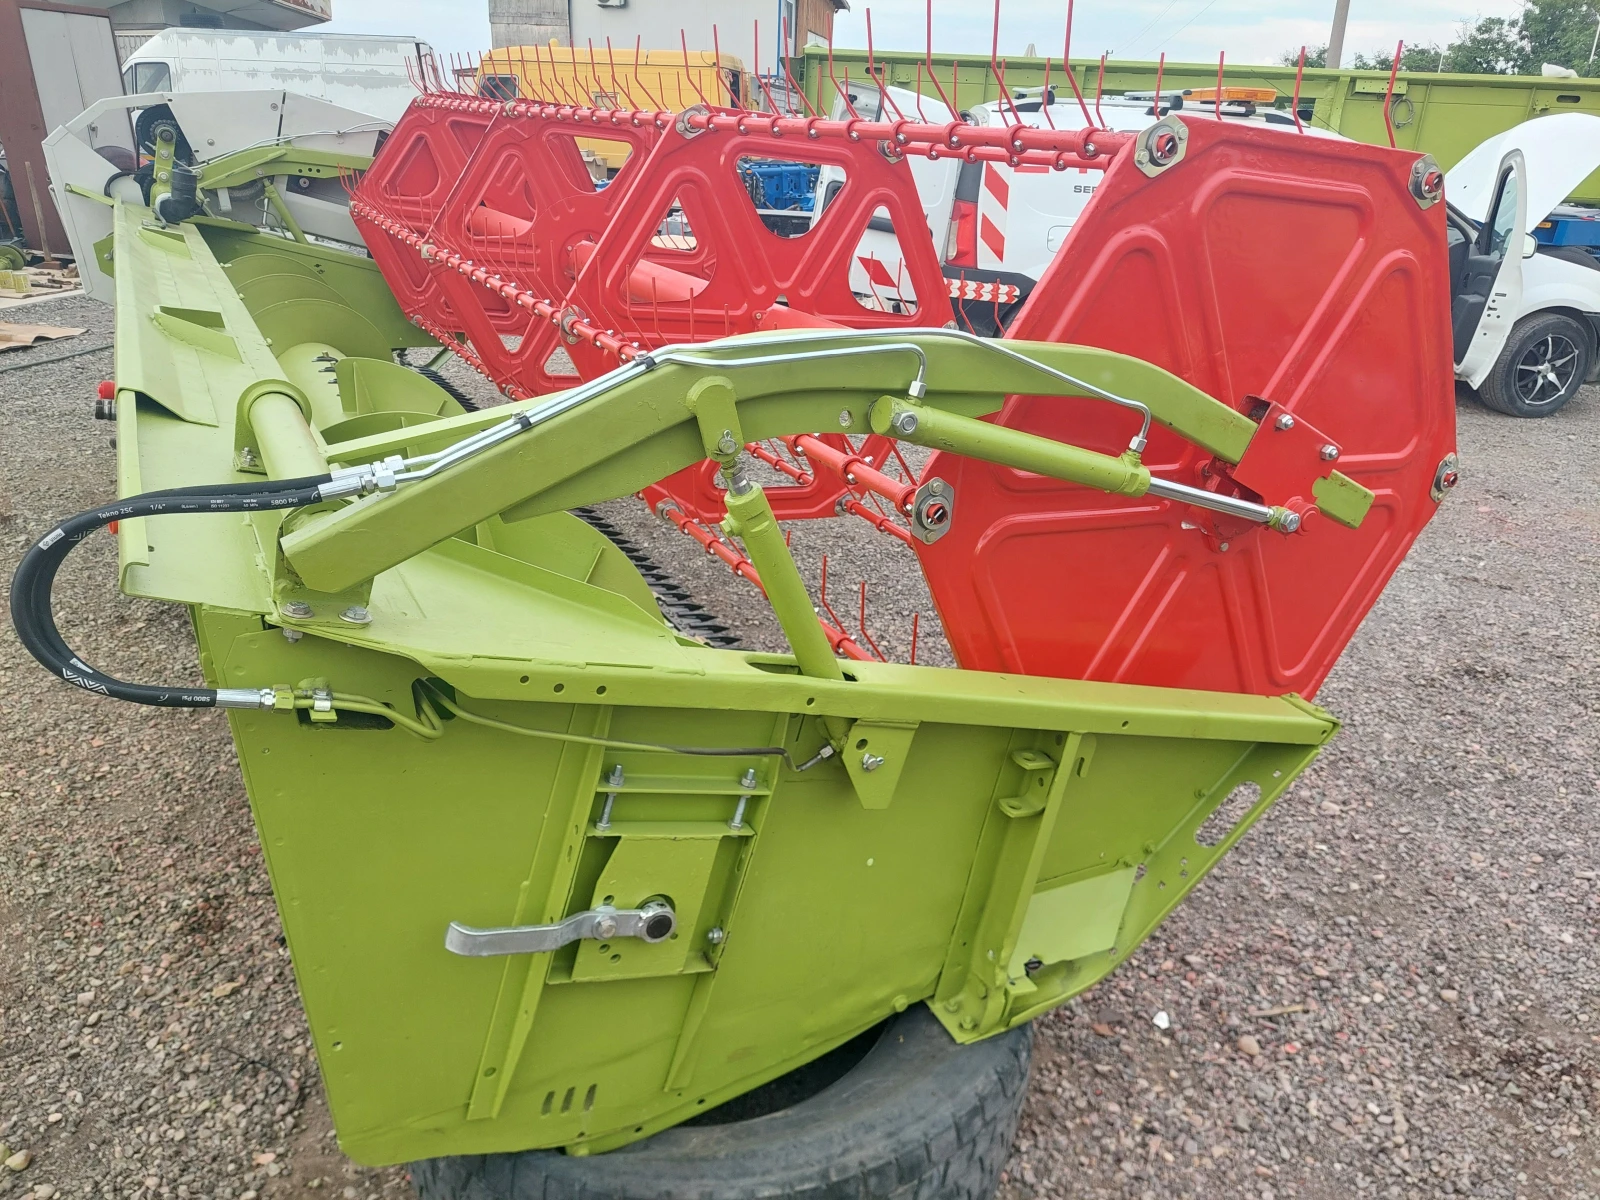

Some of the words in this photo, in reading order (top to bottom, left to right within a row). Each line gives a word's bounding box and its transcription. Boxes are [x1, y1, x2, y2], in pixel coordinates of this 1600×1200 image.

[270, 498, 288, 506] 5800
[288, 496, 299, 504] Psi
[97, 510, 119, 519] Tekno
[119, 506, 134, 515] 2SC
